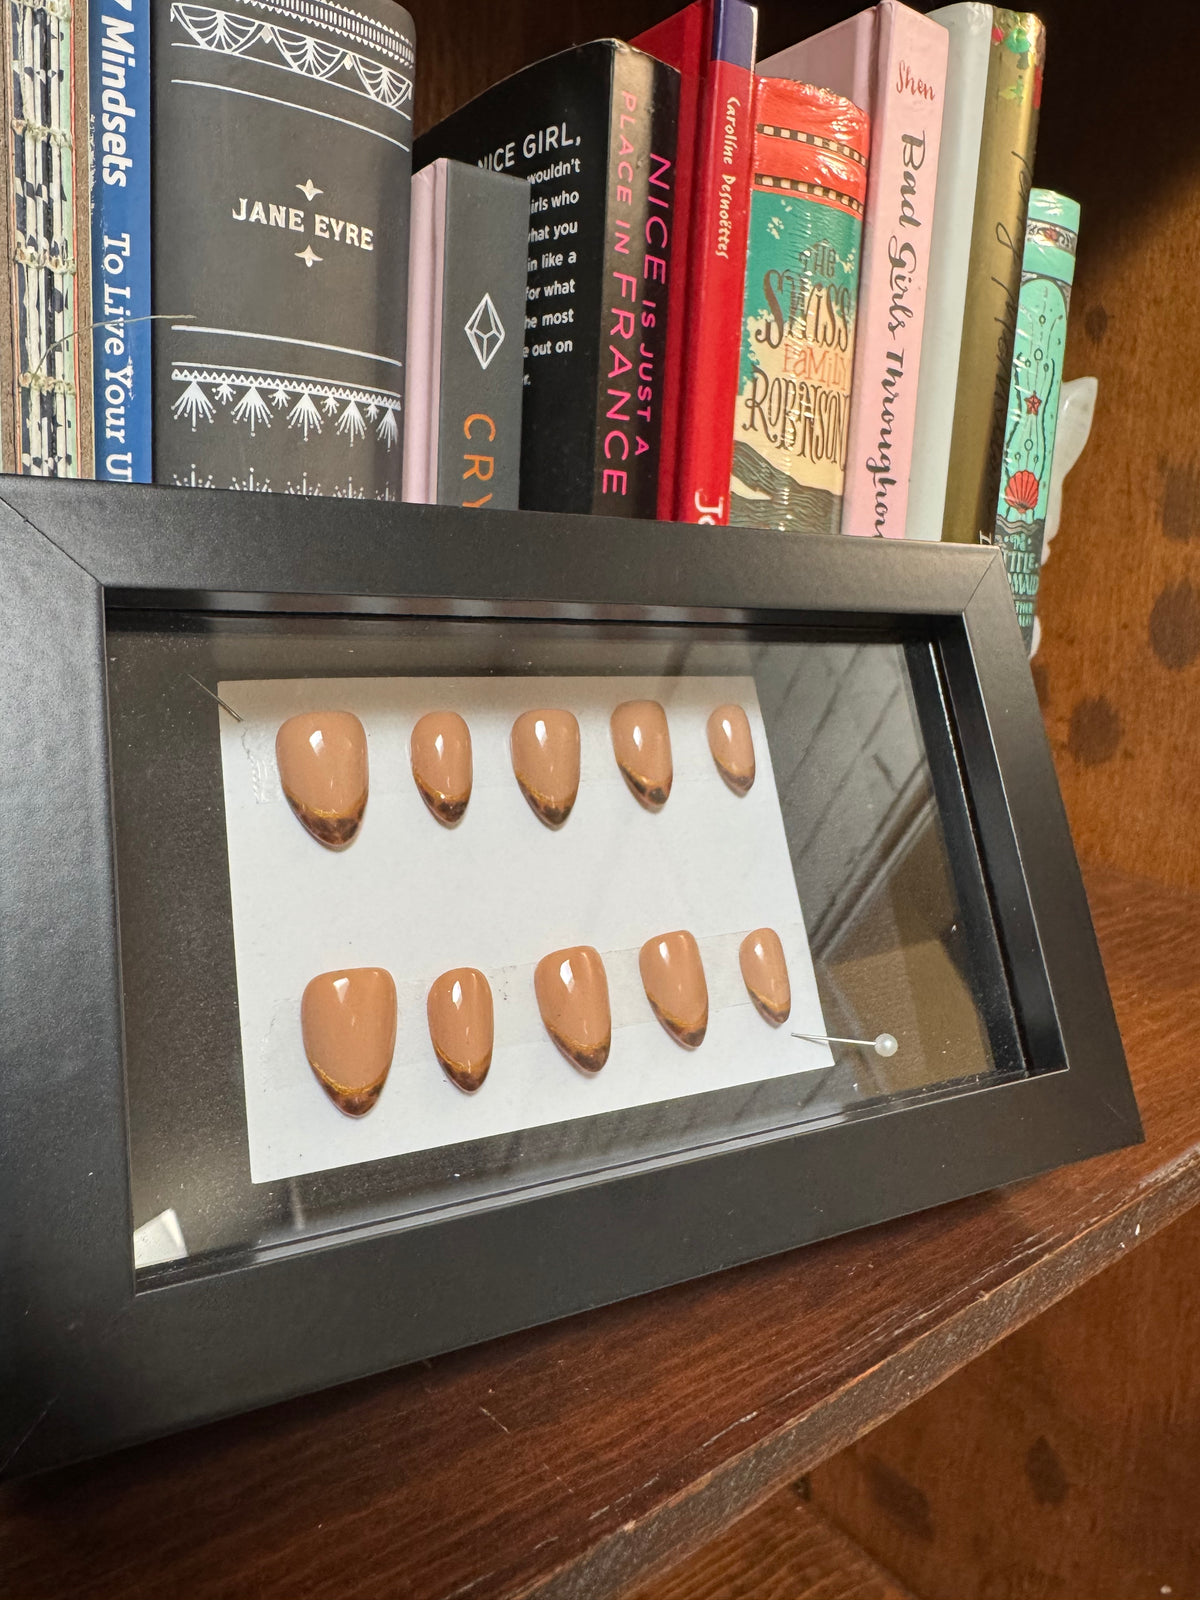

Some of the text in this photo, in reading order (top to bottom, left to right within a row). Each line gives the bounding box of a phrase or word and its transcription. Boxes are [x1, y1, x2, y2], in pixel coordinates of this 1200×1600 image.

[101, 15, 136, 187] Mindsets
[896, 60, 935, 101] Shen
[523, 122, 581, 159] GIRL,
[722, 96, 741, 165] Caroline
[527, 158, 581, 184] wouldn't
[899, 130, 926, 228] Bad
[550, 189, 580, 208] who
[232, 198, 374, 251] JANE EYRE
[528, 221, 578, 243] hat you
[103, 233, 131, 275] To
[541, 252, 564, 269] like
[567, 251, 577, 264] a
[543, 278, 576, 297] what
[602, 90, 637, 496] PLACE IN FRANCE
[635, 153, 671, 456] NICE IS JUST A
[888, 235, 917, 341] Girls
[103, 283, 131, 355] Live
[541, 308, 574, 327] most
[532, 340, 552, 357] out
[555, 340, 573, 353] on
[104, 368, 134, 444] Your
[105, 451, 132, 482] U
